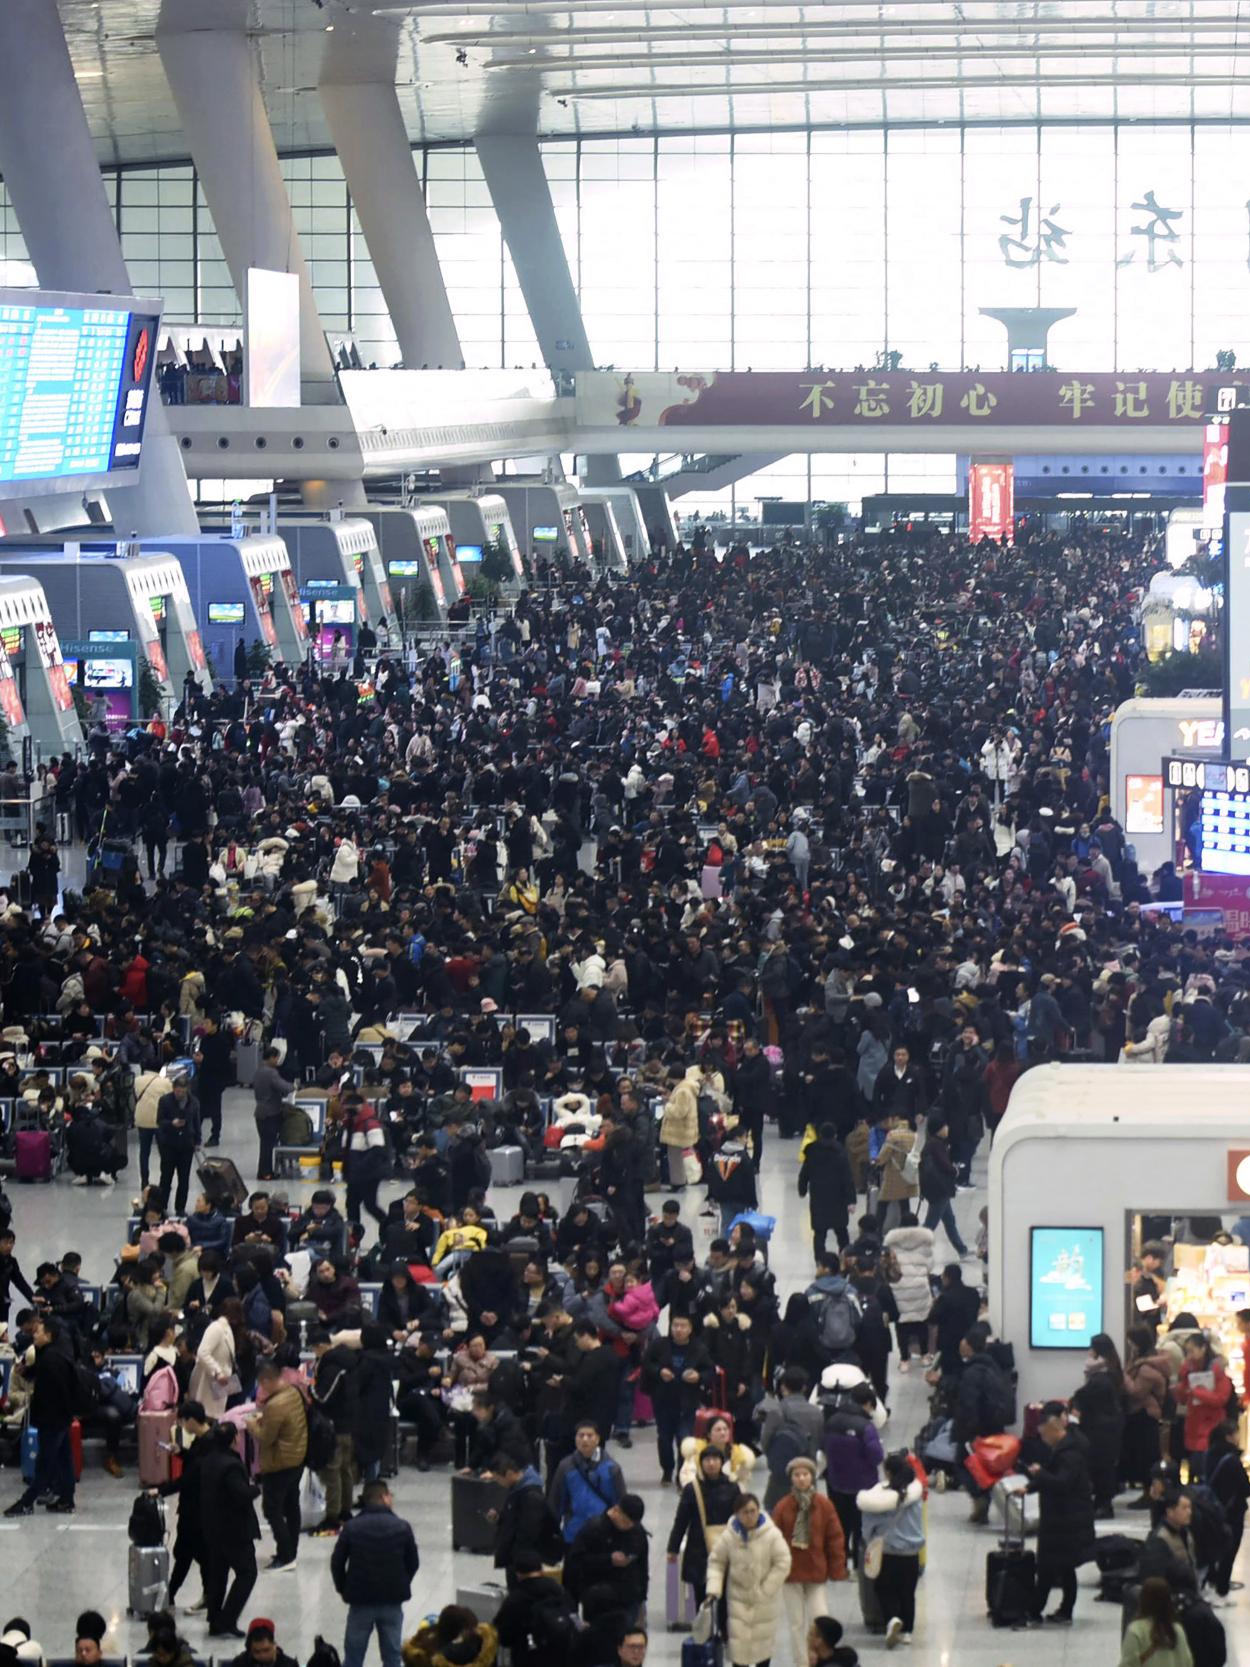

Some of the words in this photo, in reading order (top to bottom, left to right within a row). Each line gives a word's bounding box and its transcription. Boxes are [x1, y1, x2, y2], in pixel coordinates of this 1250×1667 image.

[798, 379, 998, 419] 不忘初心
[1057, 379, 1244, 420] 牢记使
